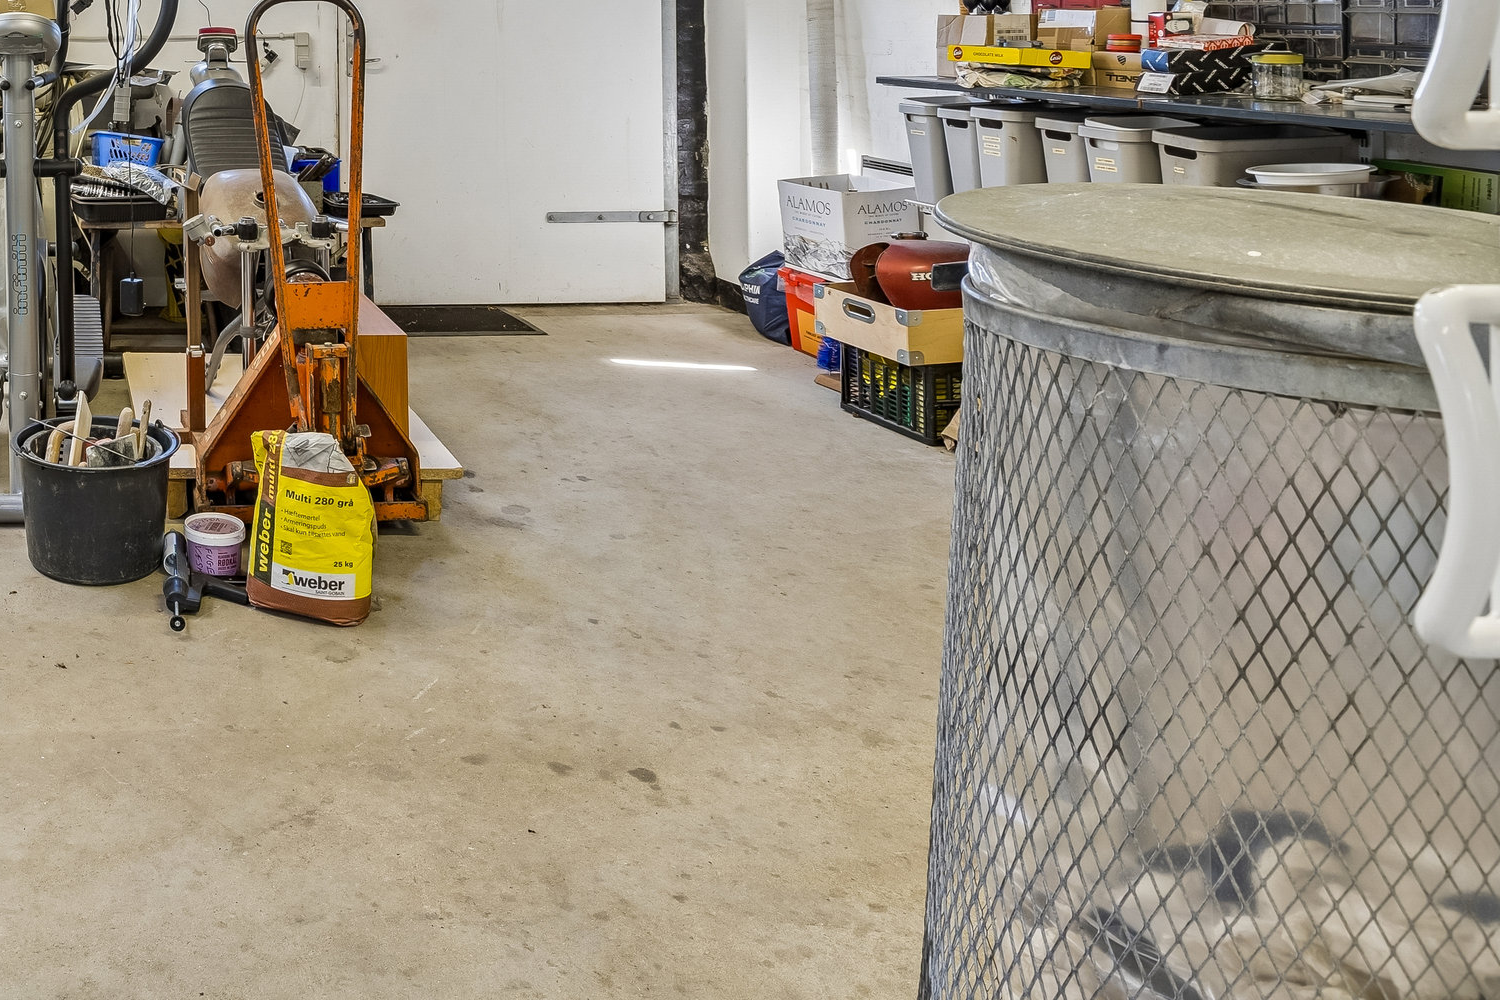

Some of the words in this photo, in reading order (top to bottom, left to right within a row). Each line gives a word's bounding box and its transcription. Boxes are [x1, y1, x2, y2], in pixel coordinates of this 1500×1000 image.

[786, 195, 831, 216] ALAMOS
[857, 201, 908, 215] ALAMOS
[792, 216, 826, 228] CHARDONNAY
[864, 217, 902, 225] CHARDONNAY
[285, 489, 312, 505] Multi
[314, 496, 335, 506] 280
[337, 498, 355, 508] grå
[259, 507, 273, 573] weber
[266, 456, 277, 500] multi
[283, 524, 296, 534] Skal
[344, 560, 354, 569] kg
[293, 575, 345, 591] weber
